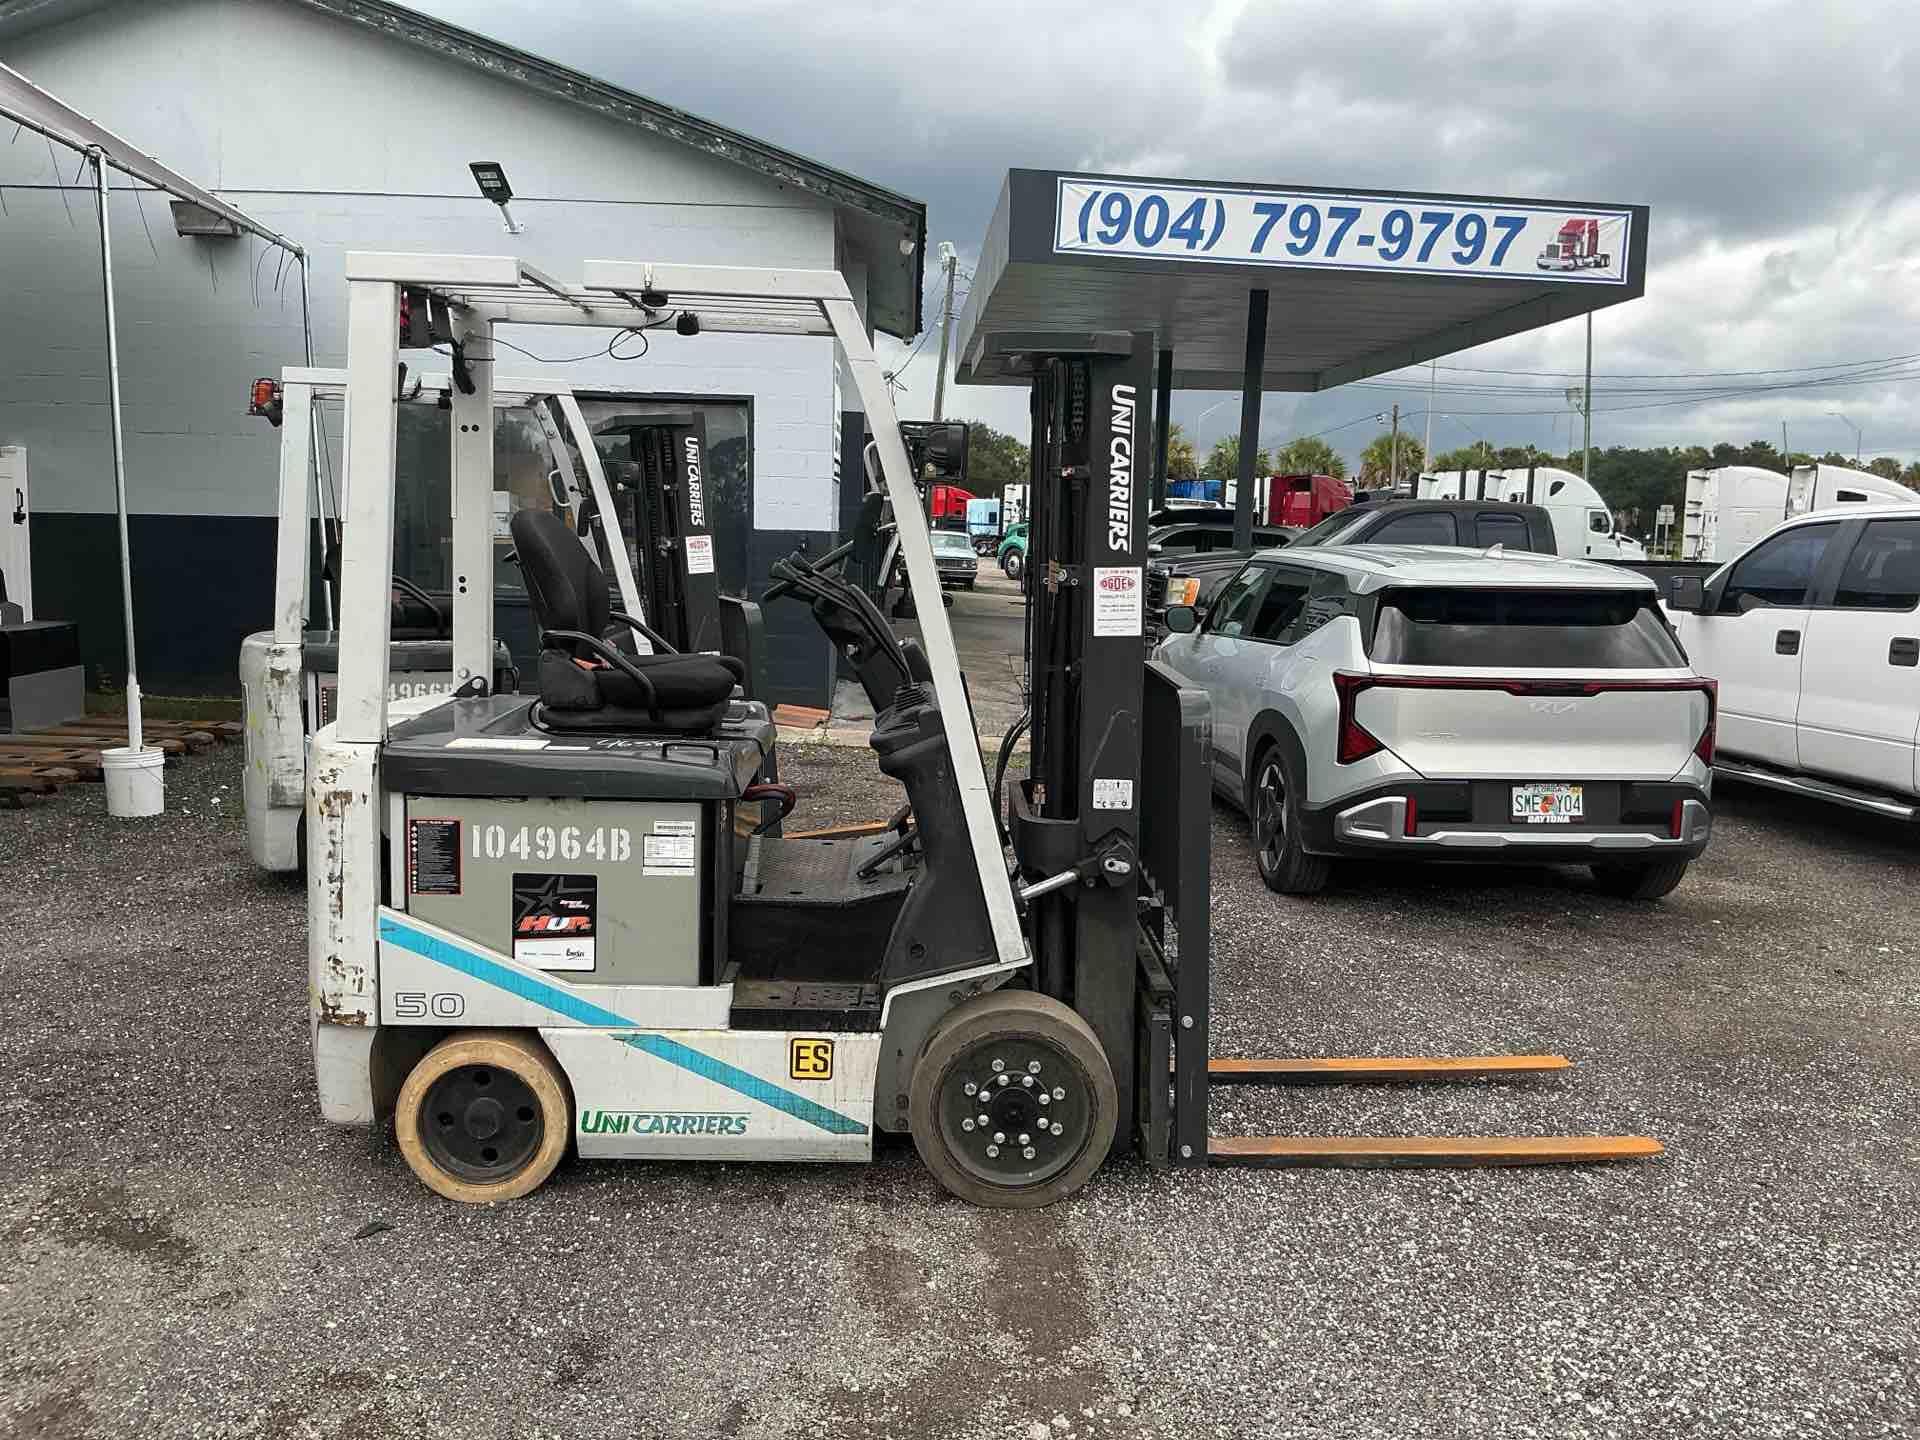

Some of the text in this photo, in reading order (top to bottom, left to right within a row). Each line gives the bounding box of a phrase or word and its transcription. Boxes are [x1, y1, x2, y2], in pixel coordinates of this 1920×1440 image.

[1078, 190, 1528, 267] (904) 797-9797
[472, 824, 631, 862] 104964B
[395, 992, 466, 1018] 50
[795, 1042, 830, 1075] ES
